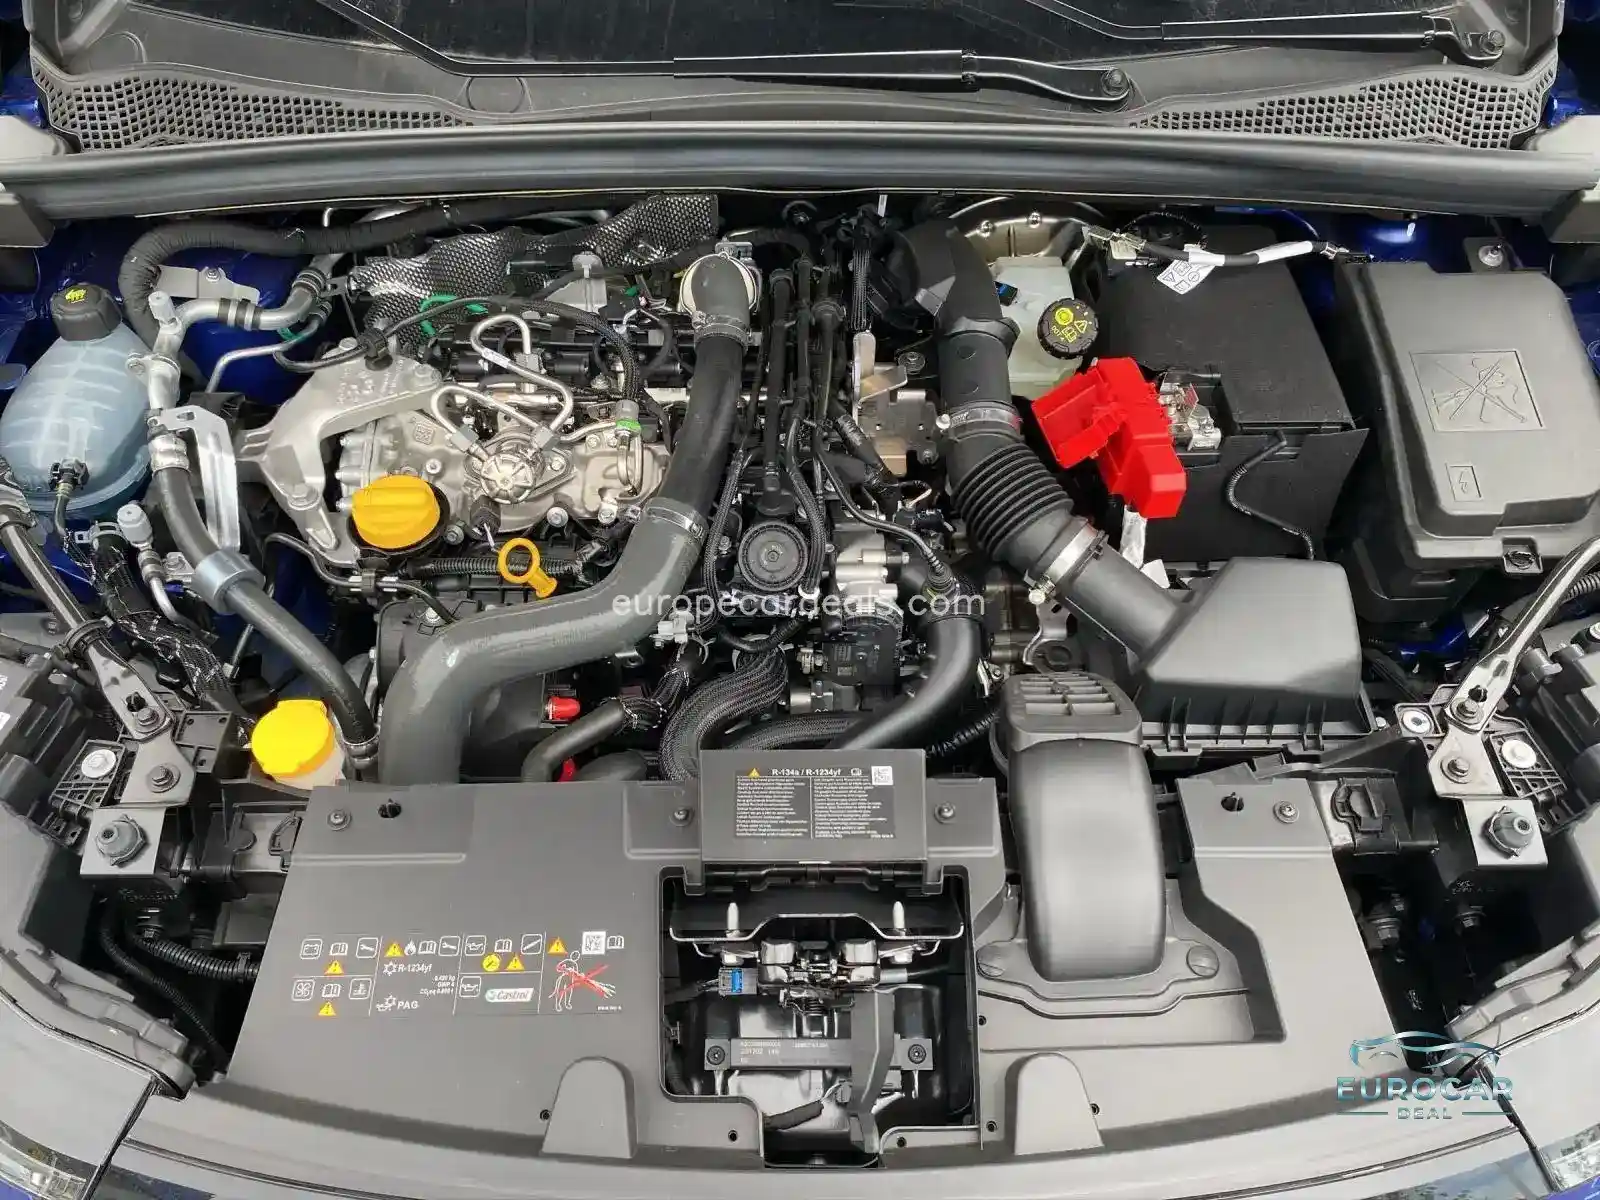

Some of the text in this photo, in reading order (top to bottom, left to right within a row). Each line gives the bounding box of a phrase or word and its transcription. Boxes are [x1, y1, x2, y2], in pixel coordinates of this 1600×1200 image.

[772, 768, 799, 776] R-134a
[806, 768, 842, 777] R-1234yf
[397, 963, 433, 974] R-1234yf
[496, 989, 529, 1001] Castrol
[397, 1000, 419, 1010] PAG
